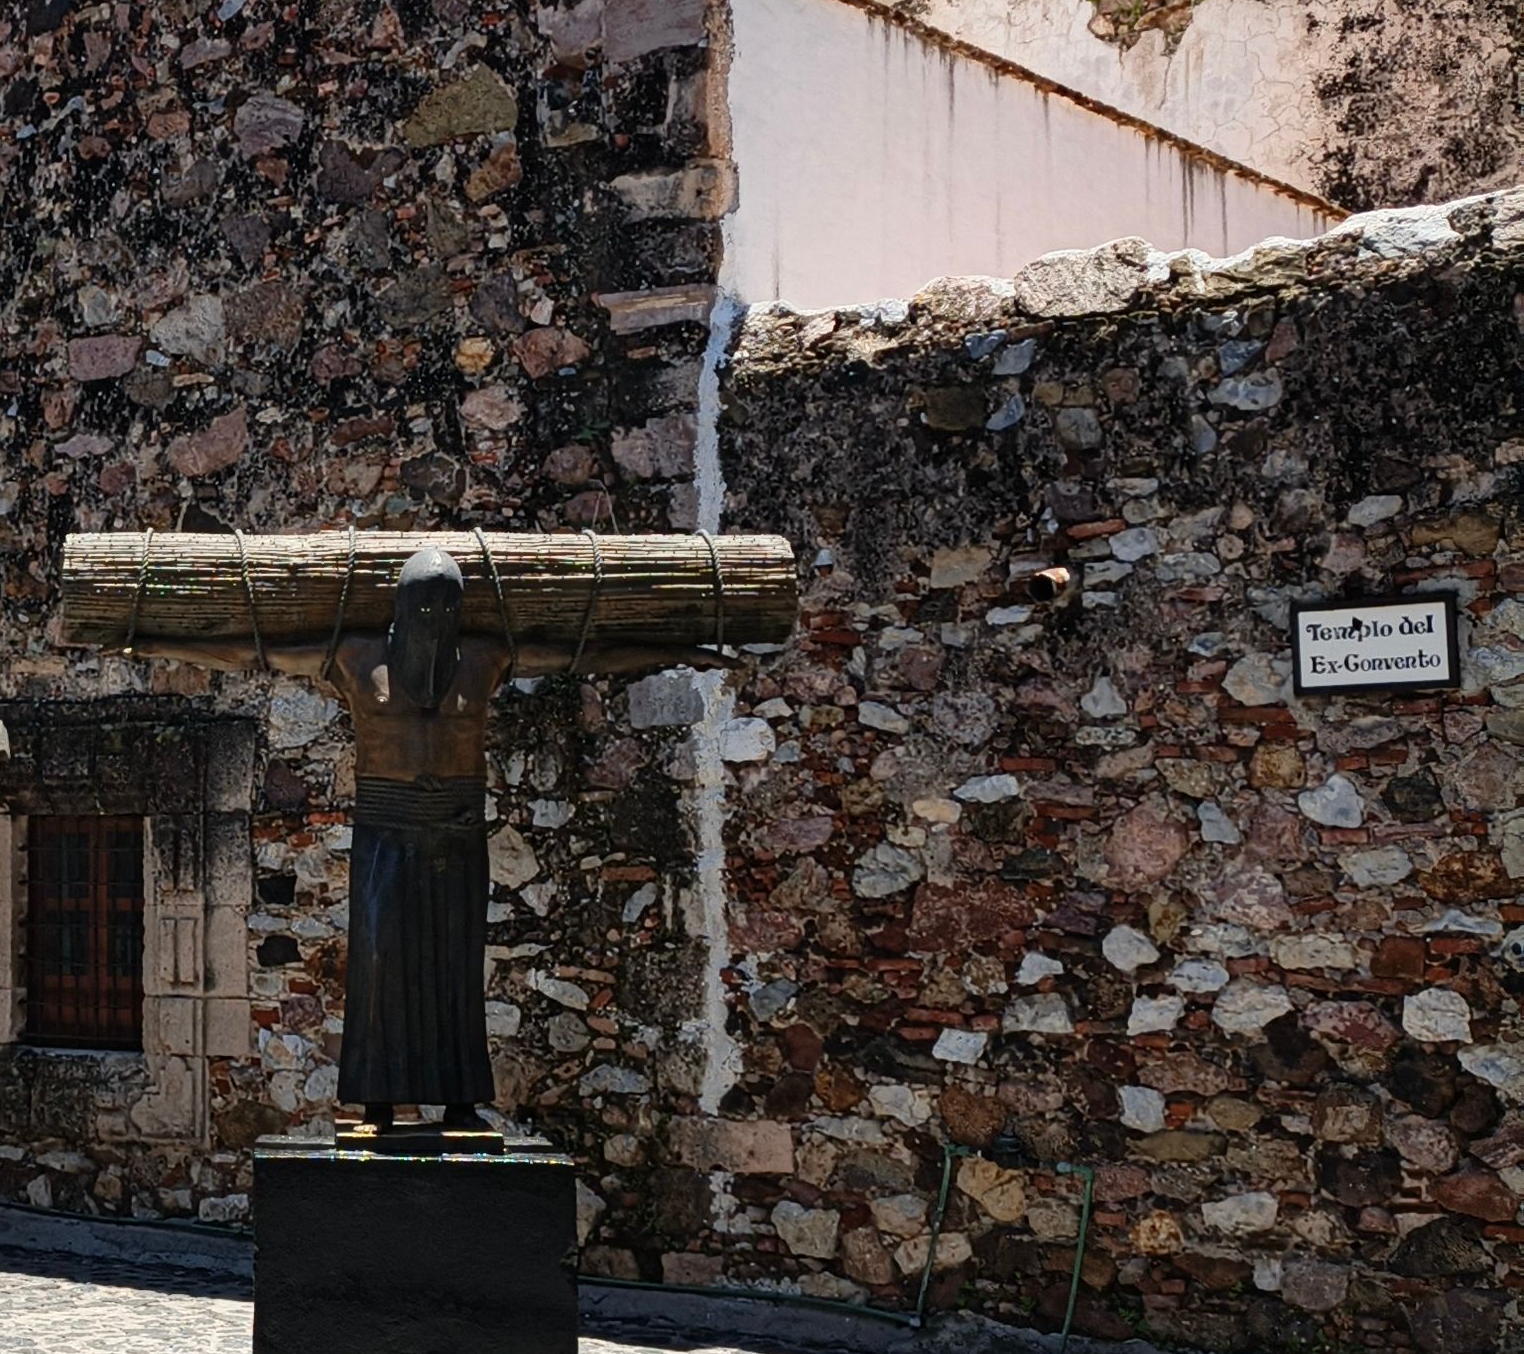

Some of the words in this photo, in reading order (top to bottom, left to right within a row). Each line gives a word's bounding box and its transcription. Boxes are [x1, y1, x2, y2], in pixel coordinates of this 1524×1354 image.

[1305, 620, 1394, 642] Templo
[1398, 615, 1435, 635] del
[1310, 649, 1442, 674] Ex-Convento
